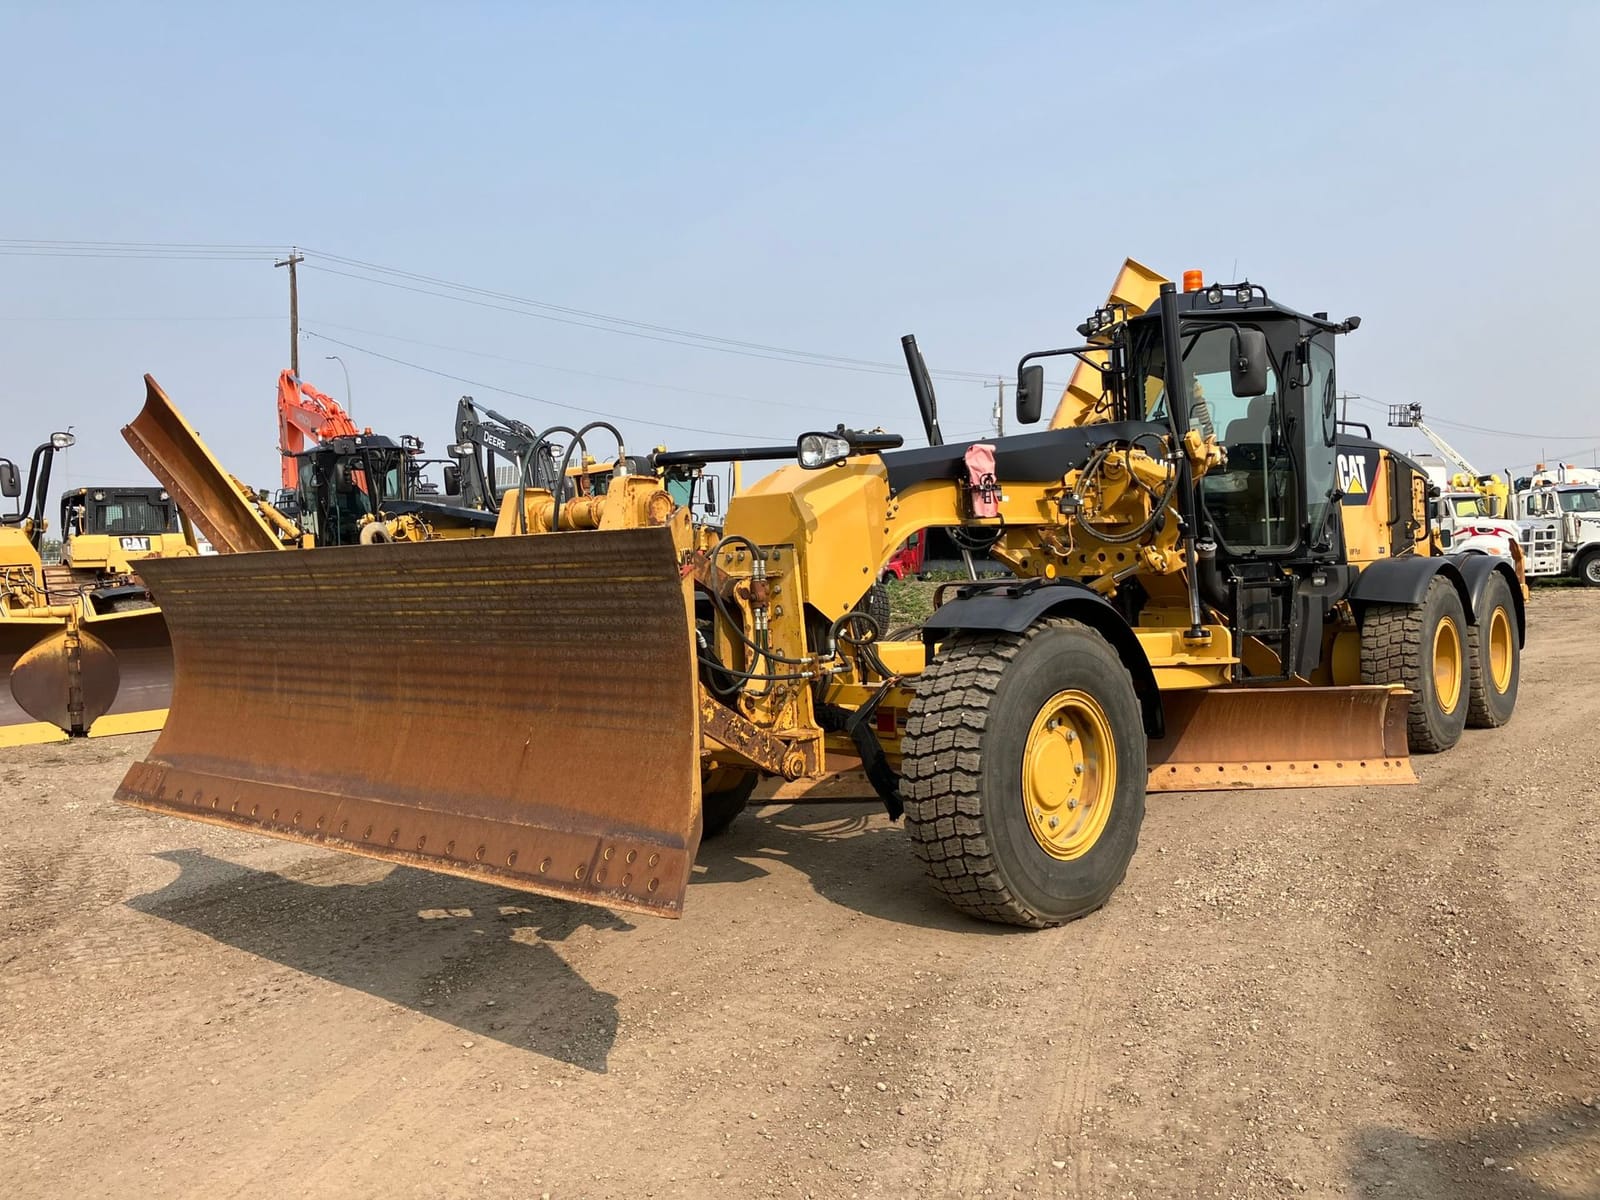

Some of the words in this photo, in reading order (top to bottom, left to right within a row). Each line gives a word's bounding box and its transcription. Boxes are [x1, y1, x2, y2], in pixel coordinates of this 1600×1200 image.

[483, 430, 506, 450] DEERE
[1337, 453, 1367, 493] CAT
[122, 537, 148, 549] CAT
